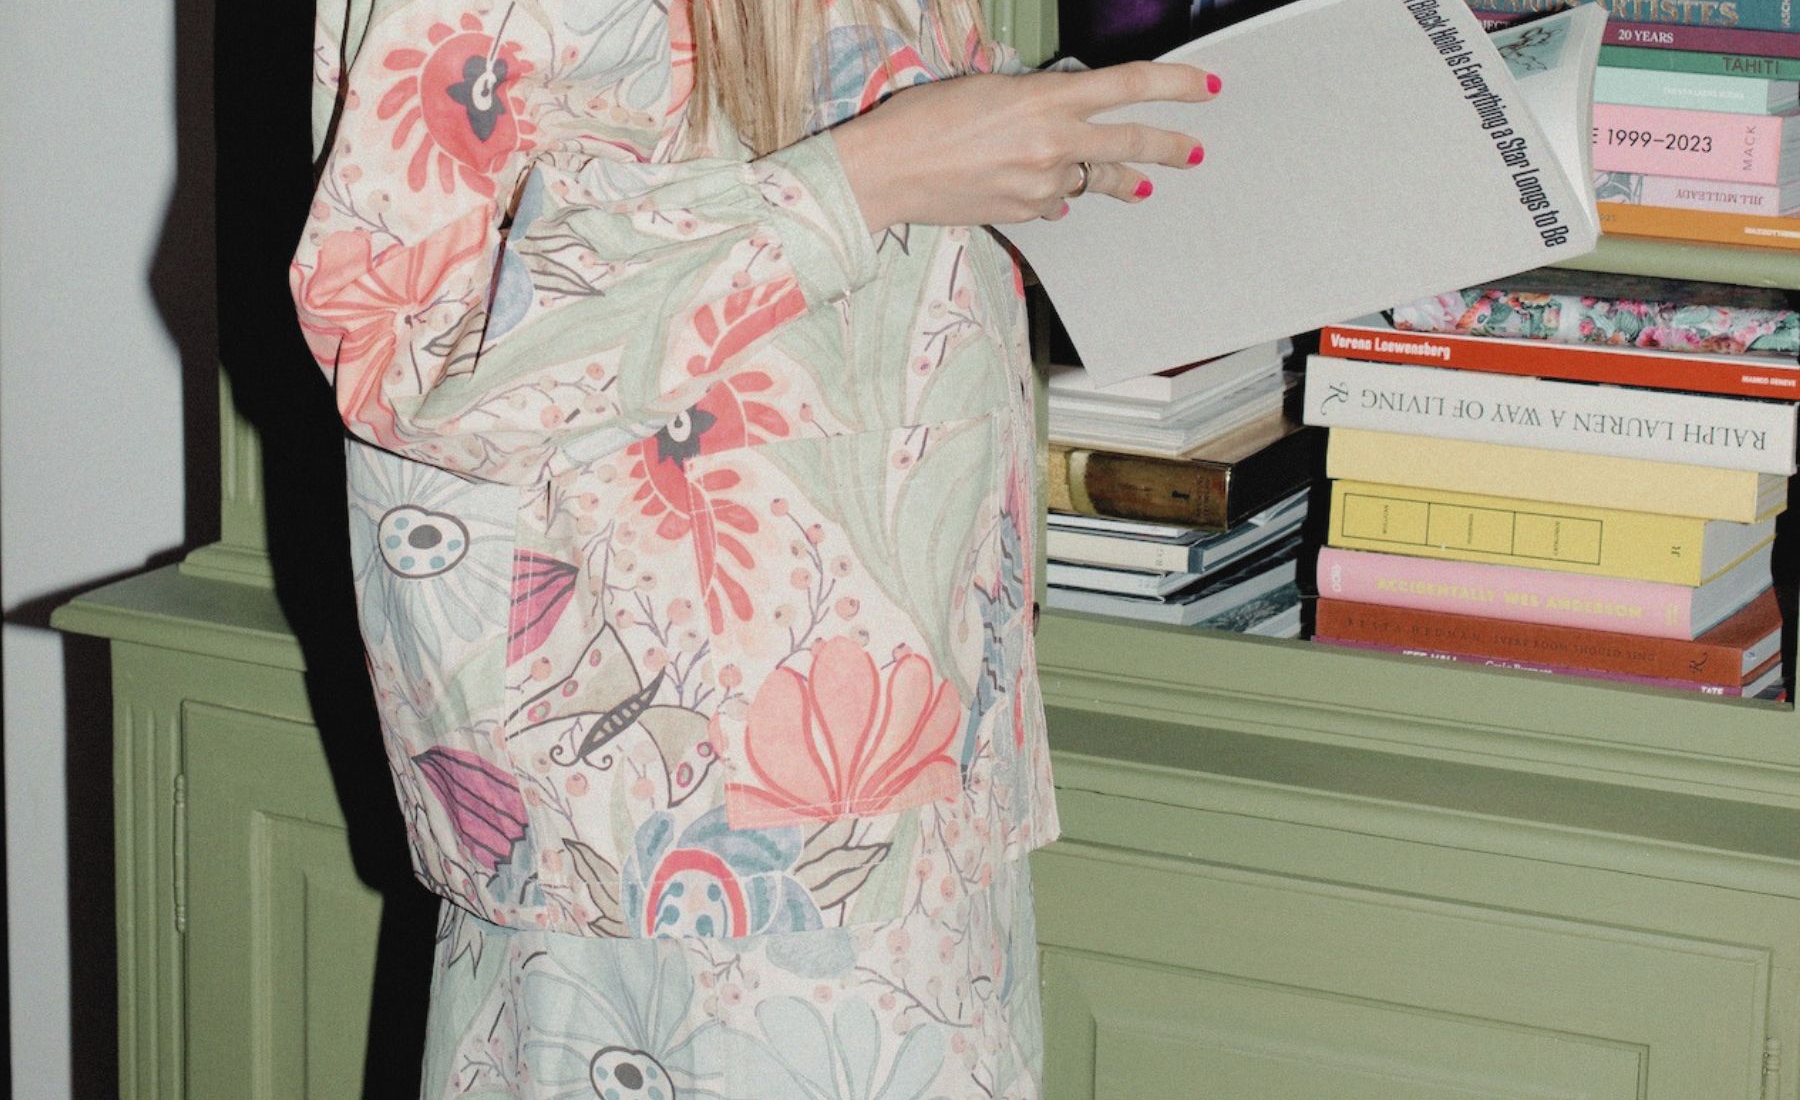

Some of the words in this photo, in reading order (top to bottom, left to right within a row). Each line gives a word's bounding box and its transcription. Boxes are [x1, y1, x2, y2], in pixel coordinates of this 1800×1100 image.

[1428, 26, 1466, 57] Hole
[1617, 29, 1632, 41] 20
[1634, 30, 1674, 45] YEARS
[1445, 51, 1473, 68] Is
[1721, 56, 1780, 75] TAHITI
[1452, 62, 1510, 131] Everything
[1491, 128, 1514, 140] a
[1496, 137, 1531, 169] Star
[1742, 125, 1757, 172] MACK
[1512, 167, 1552, 213] Longs
[1676, 188, 1738, 204] MULLEADY
[1739, 193, 1764, 206] JILL
[1533, 209, 1561, 228] to
[1540, 225, 1570, 249] Be
[1329, 333, 1372, 351] Verena
[1360, 389, 1445, 417] LIVING
[1452, 399, 1485, 421] OF
[1491, 403, 1541, 427] WAY
[1550, 409, 1566, 429] A
[1572, 412, 1674, 442] LAUREN
[1683, 423, 1767, 452] RALPH
[1376, 577, 1495, 603] ACCIDENTALLY
[1502, 591, 1541, 608] WES
[1545, 596, 1643, 619] ANDERSON
[1534, 637, 1568, 651] ROOM
